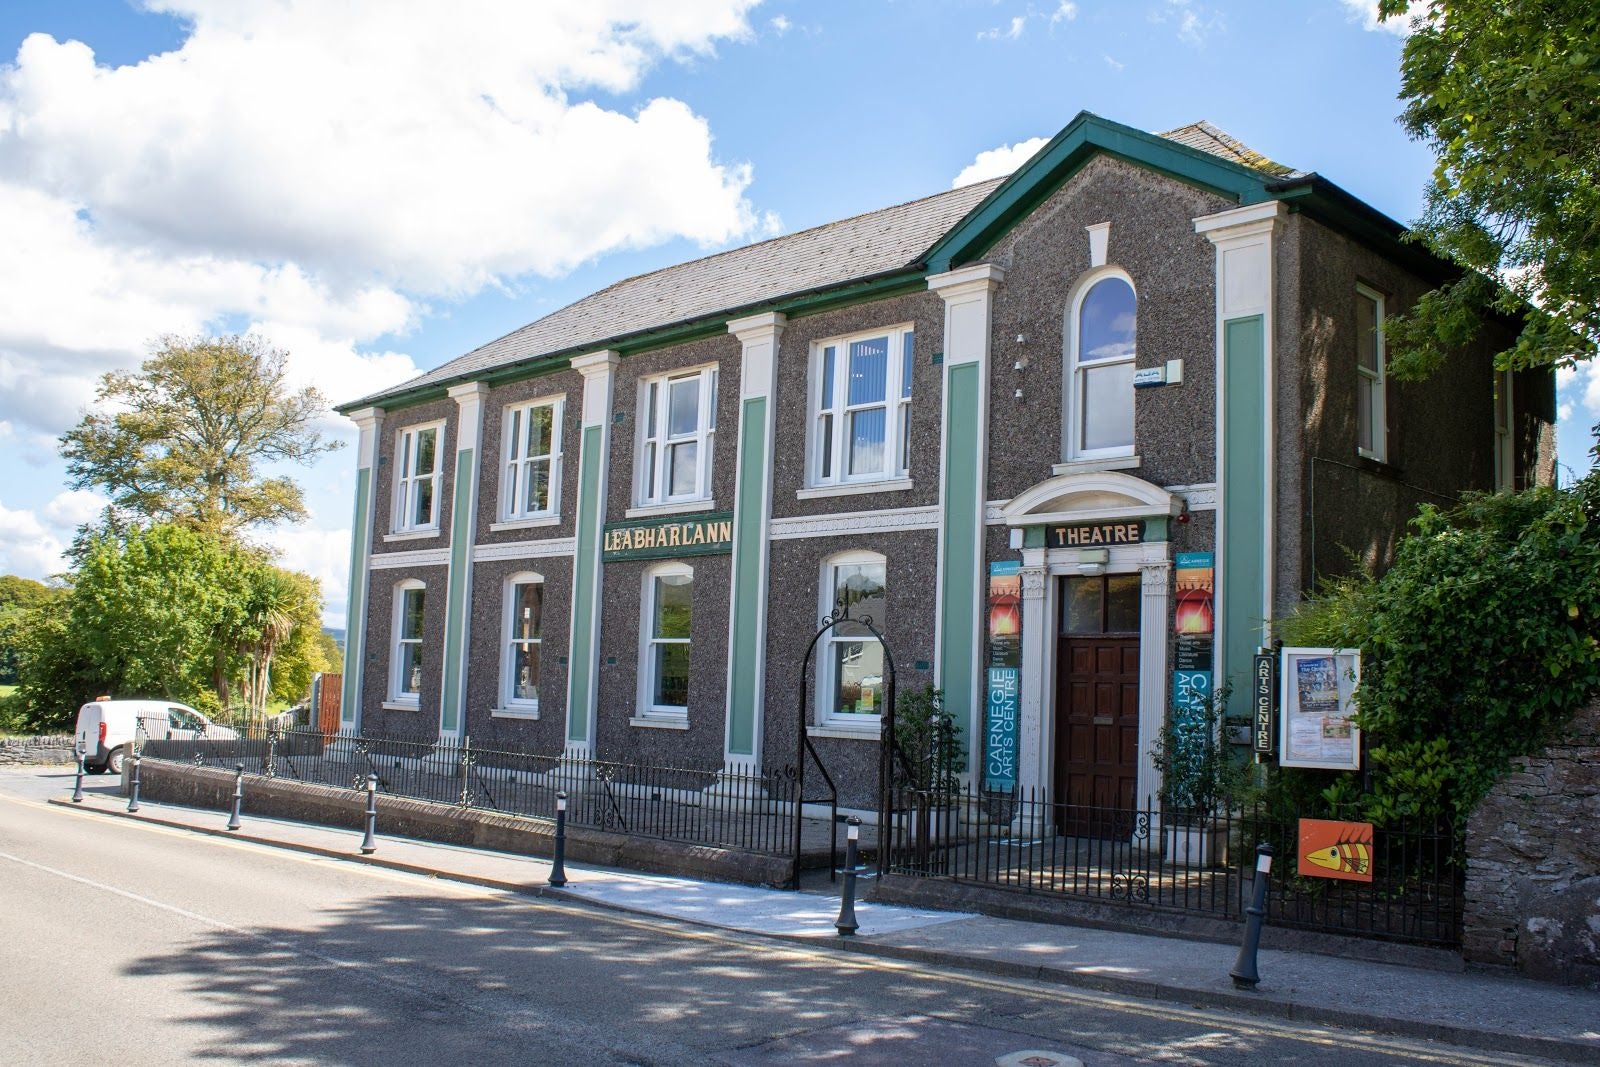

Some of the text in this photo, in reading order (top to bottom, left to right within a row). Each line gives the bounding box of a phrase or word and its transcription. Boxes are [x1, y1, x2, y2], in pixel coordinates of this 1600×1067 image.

[604, 521, 732, 552] LEABHARLANN
[1055, 523, 1140, 545] THEATRE
[989, 670, 1005, 776] CARNEGIE
[1002, 669, 1015, 778] ARTS CENTRE
[1258, 659, 1270, 748] ARTS CENTRE
